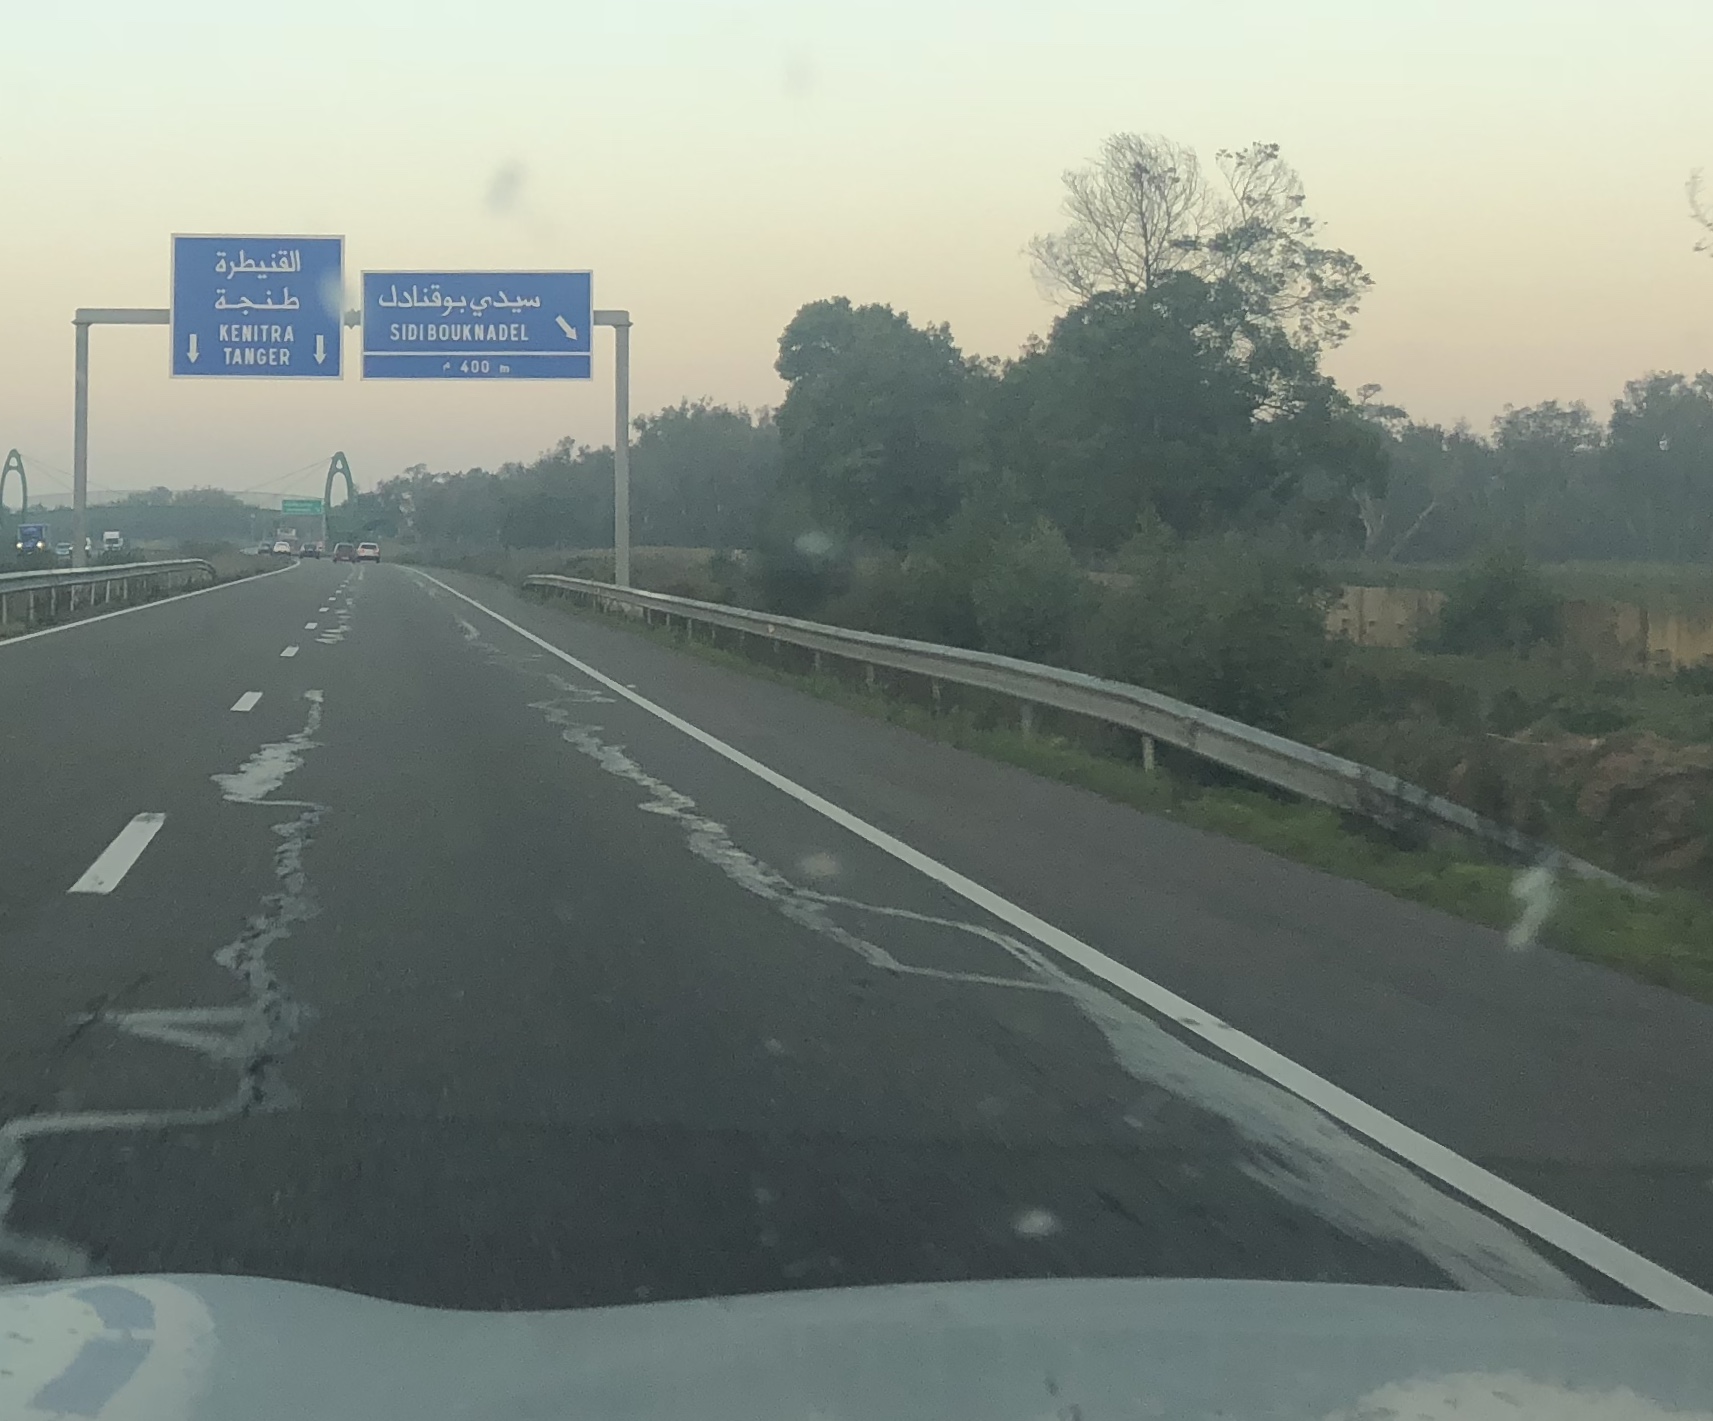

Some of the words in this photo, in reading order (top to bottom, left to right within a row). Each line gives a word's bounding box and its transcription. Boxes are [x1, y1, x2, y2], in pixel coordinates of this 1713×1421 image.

[215, 249, 301, 280] القنيطرة
[214, 286, 300, 316] طنجة
[469, 290, 541, 317] سيدي
[219, 324, 294, 342] KENITRA
[390, 323, 424, 341] SIDI
[427, 323, 529, 341] BOUKNADEL
[223, 347, 290, 366] TANGER
[460, 359, 490, 374] 400
[499, 364, 510, 373] m
